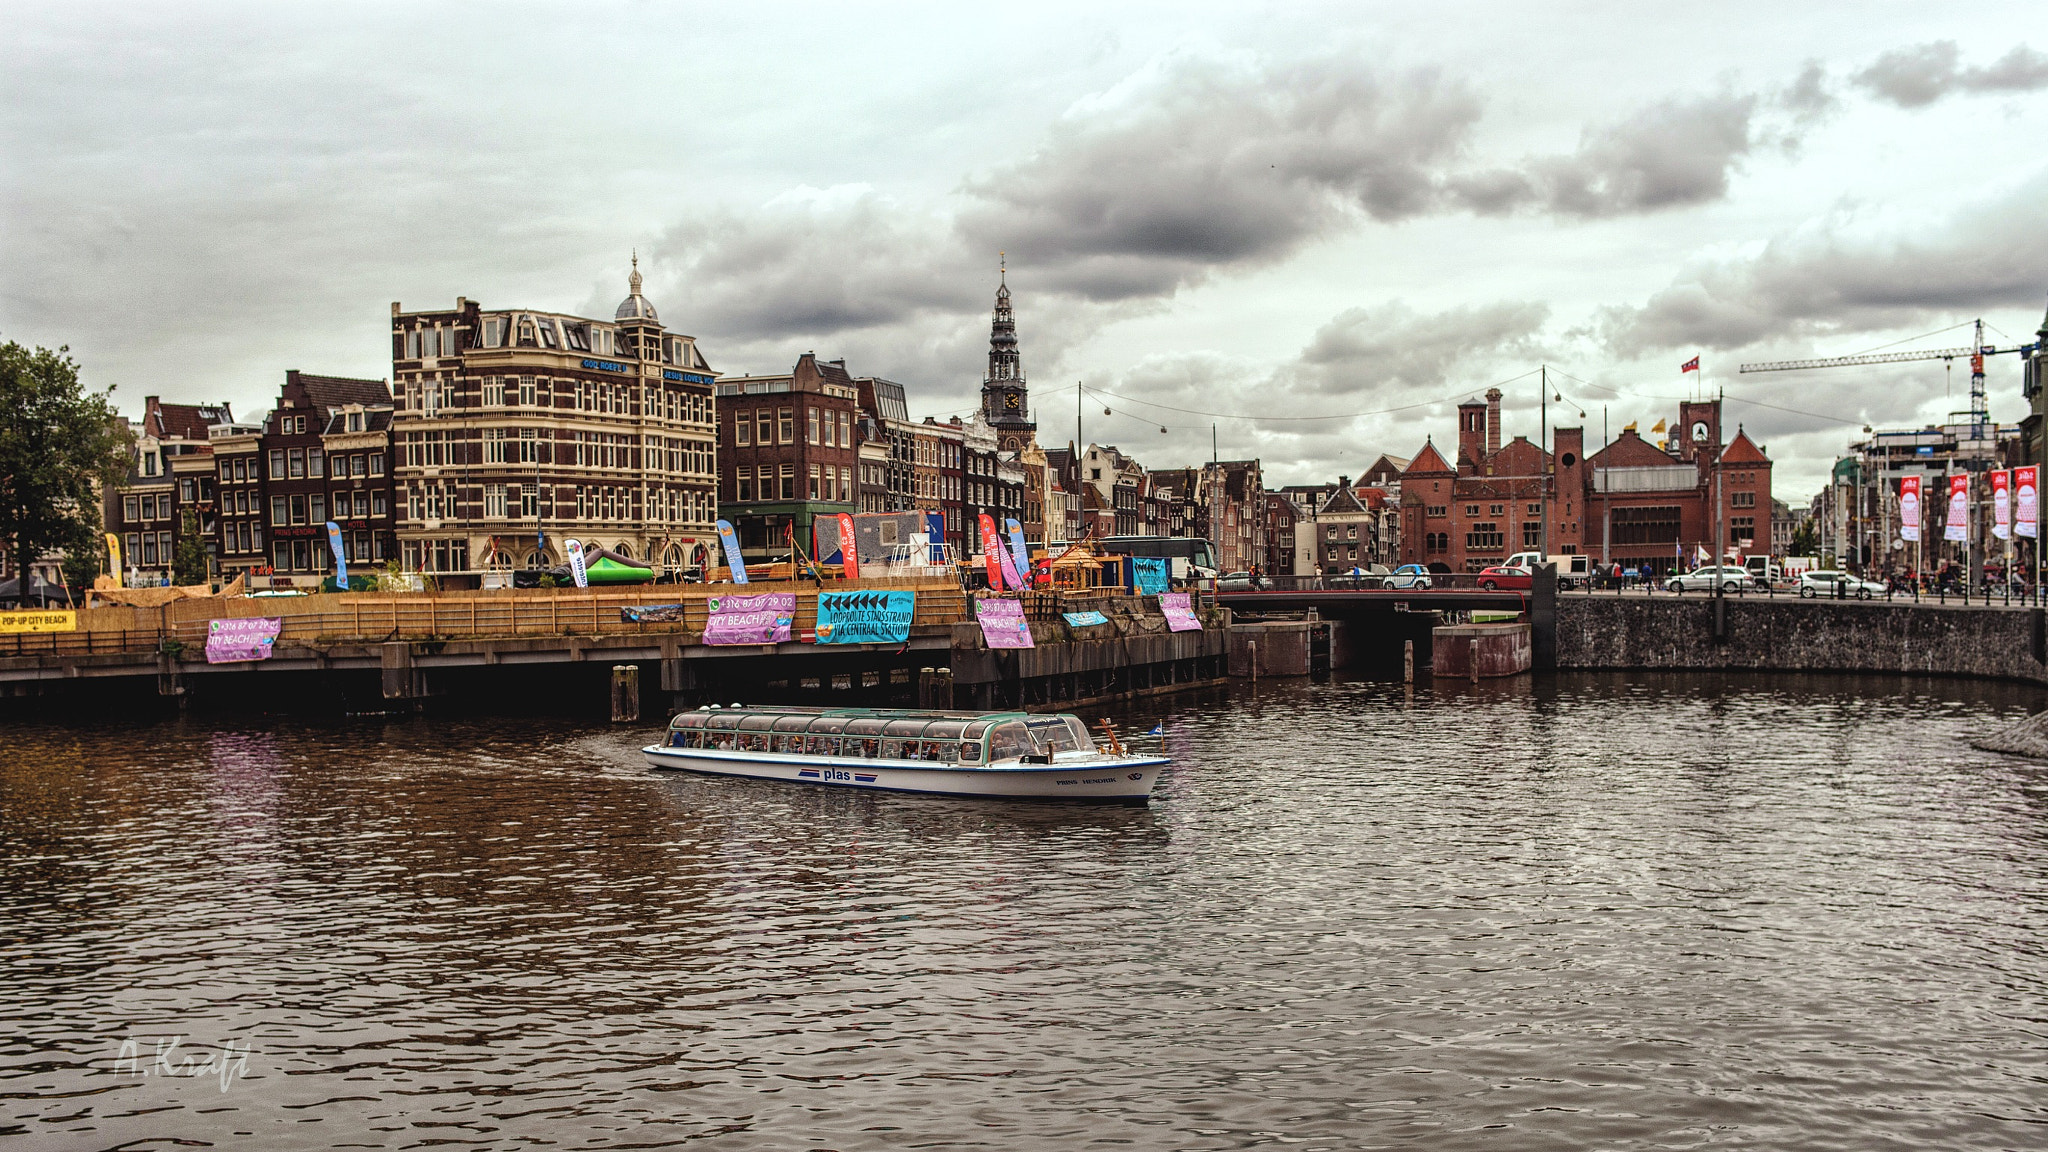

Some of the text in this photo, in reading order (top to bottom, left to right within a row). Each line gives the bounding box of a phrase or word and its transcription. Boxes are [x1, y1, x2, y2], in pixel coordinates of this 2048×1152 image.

[583, 360, 598, 368] GOD
[664, 371, 683, 380] JESUS
[684, 373, 702, 382] LOVES
[347, 520, 367, 529] HOTEL
[274, 527, 317, 536] PRINS HENDRIK
[721, 597, 793, 609] +316 87 07 29 02
[2, 615, 67, 625] POP-UP CITY BEACH
[709, 614, 760, 626] CITY BEACH
[830, 610, 912, 623] LOOPROUTE STADSSTRAND
[237, 622, 247, 630] 87
[248, 621, 258, 630] 07
[259, 621, 268, 629] 29
[834, 622, 909, 637] VIA CENTRAAL STATION
[209, 635, 224, 645] CITY
[223, 634, 251, 645] BEACH
[823, 767, 851, 782] plas
[1082, 777, 1117, 785] HENDRIK
